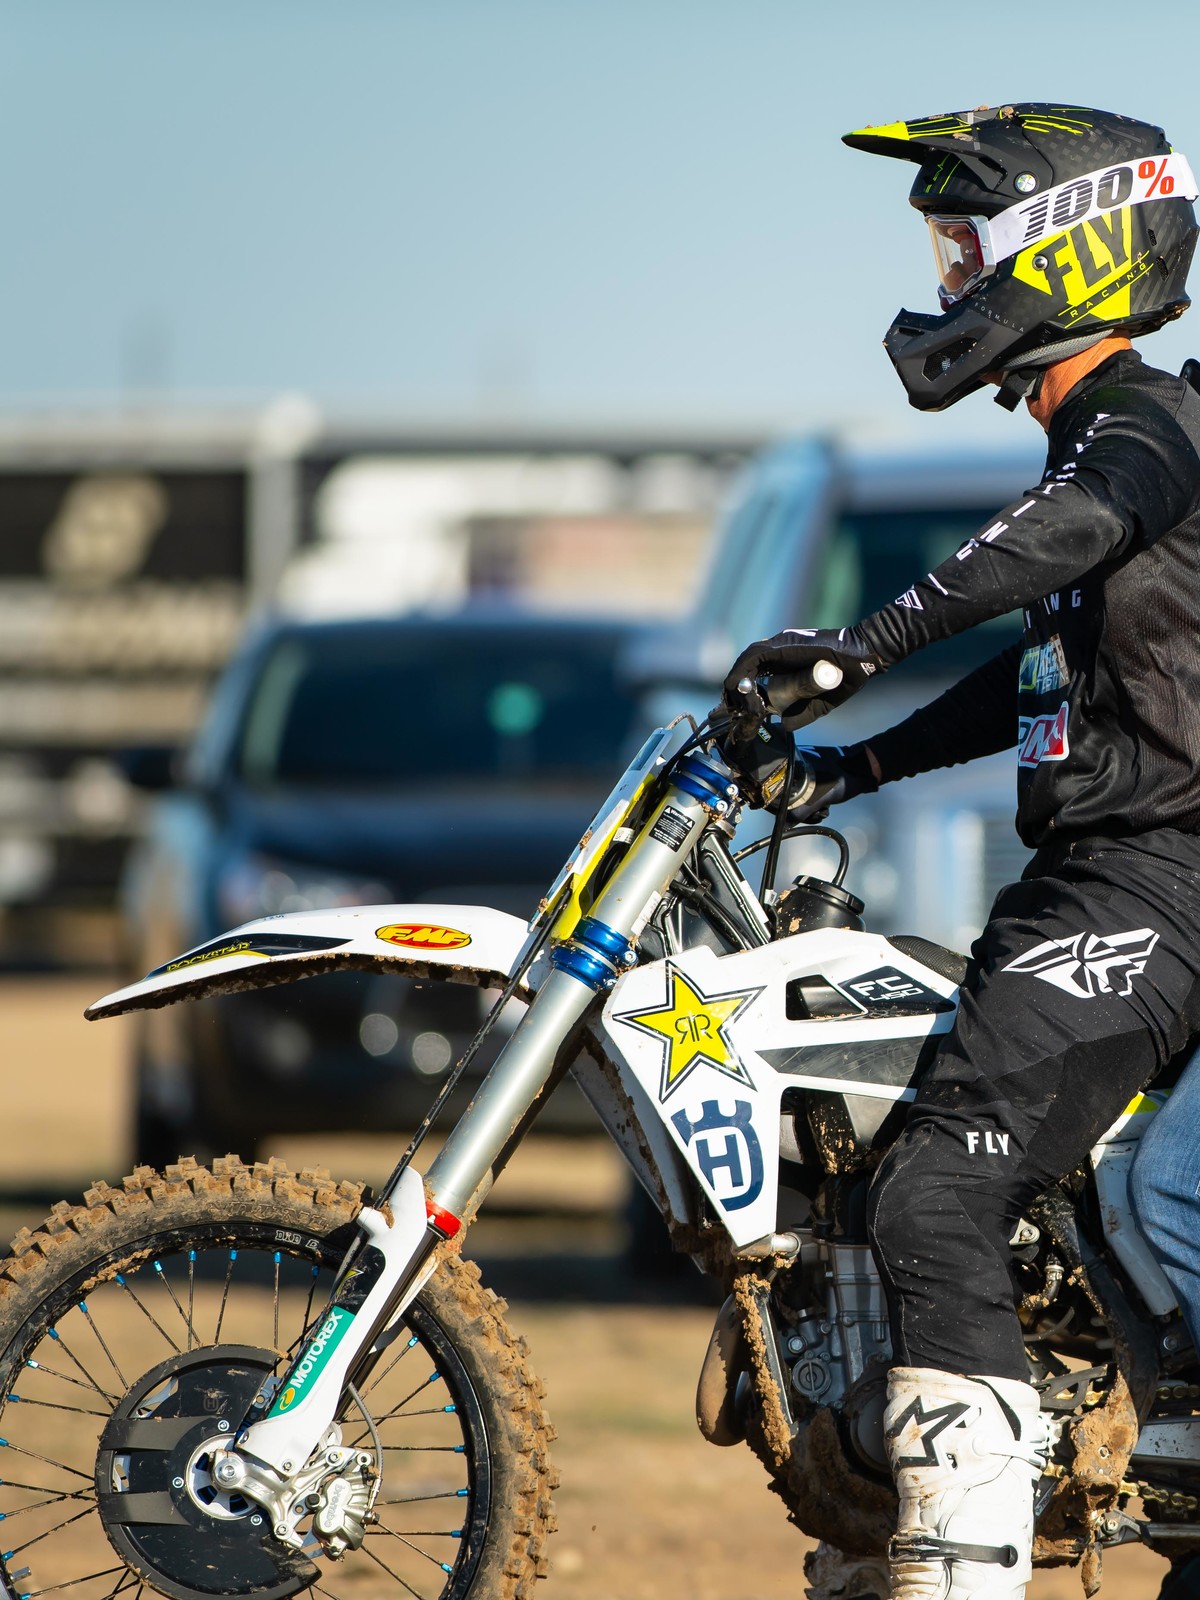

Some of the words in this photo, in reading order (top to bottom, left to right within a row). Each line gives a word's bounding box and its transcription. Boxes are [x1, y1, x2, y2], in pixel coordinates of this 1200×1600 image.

[1019, 158, 1175, 243] 100%
[1034, 208, 1129, 304] FLY
[1069, 263, 1146, 318] RACING
[974, 302, 1025, 333] FORMULA
[376, 926, 471, 945] FMF
[849, 975, 914, 997] FC
[965, 1130, 1010, 1156] FLY
[289, 1311, 344, 1389] MOTOREX
